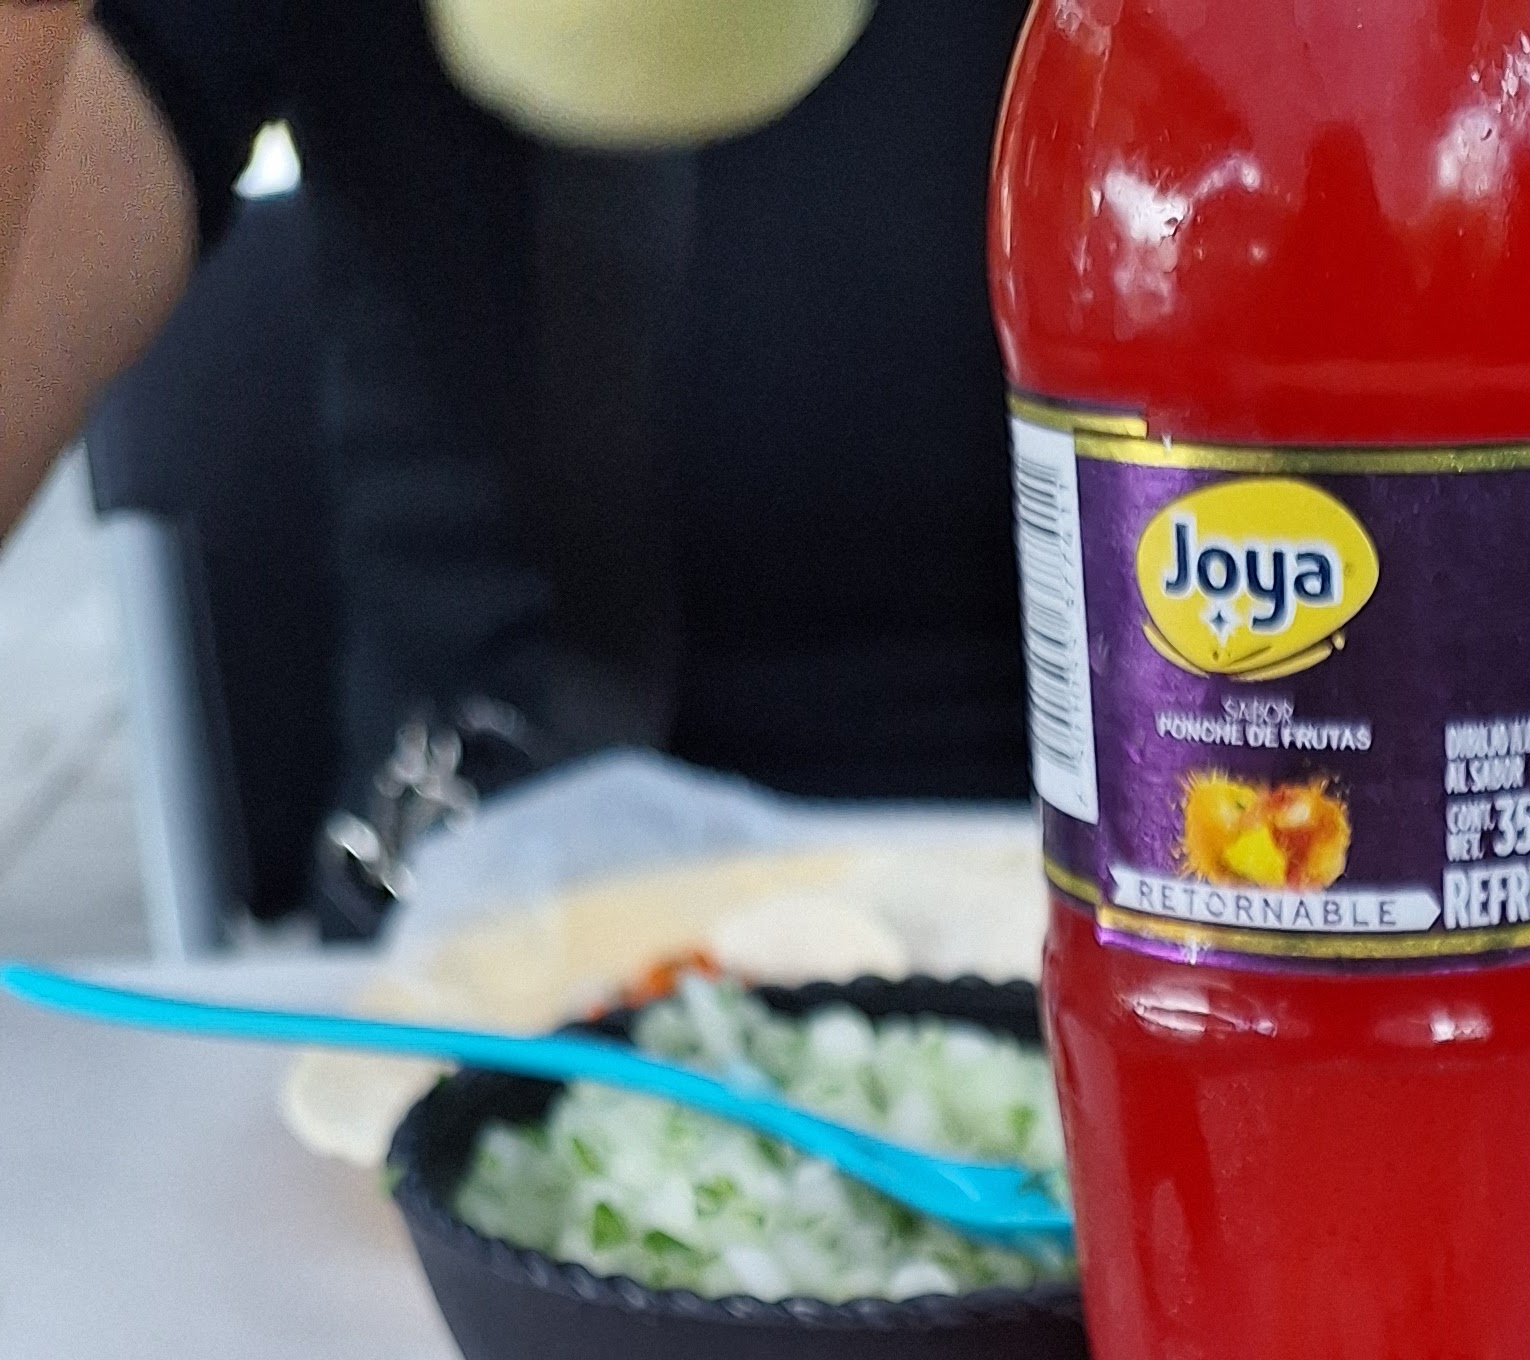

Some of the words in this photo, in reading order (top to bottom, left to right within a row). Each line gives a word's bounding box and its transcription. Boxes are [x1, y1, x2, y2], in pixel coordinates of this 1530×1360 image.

[1164, 521, 1336, 628] Joya
[1223, 698, 1293, 726] SABOR
[1246, 722, 1280, 748] DE
[1281, 722, 1372, 750] FRUTAS
[1445, 760, 1468, 794] AL
[1139, 879, 1396, 927] RETORNABLE
